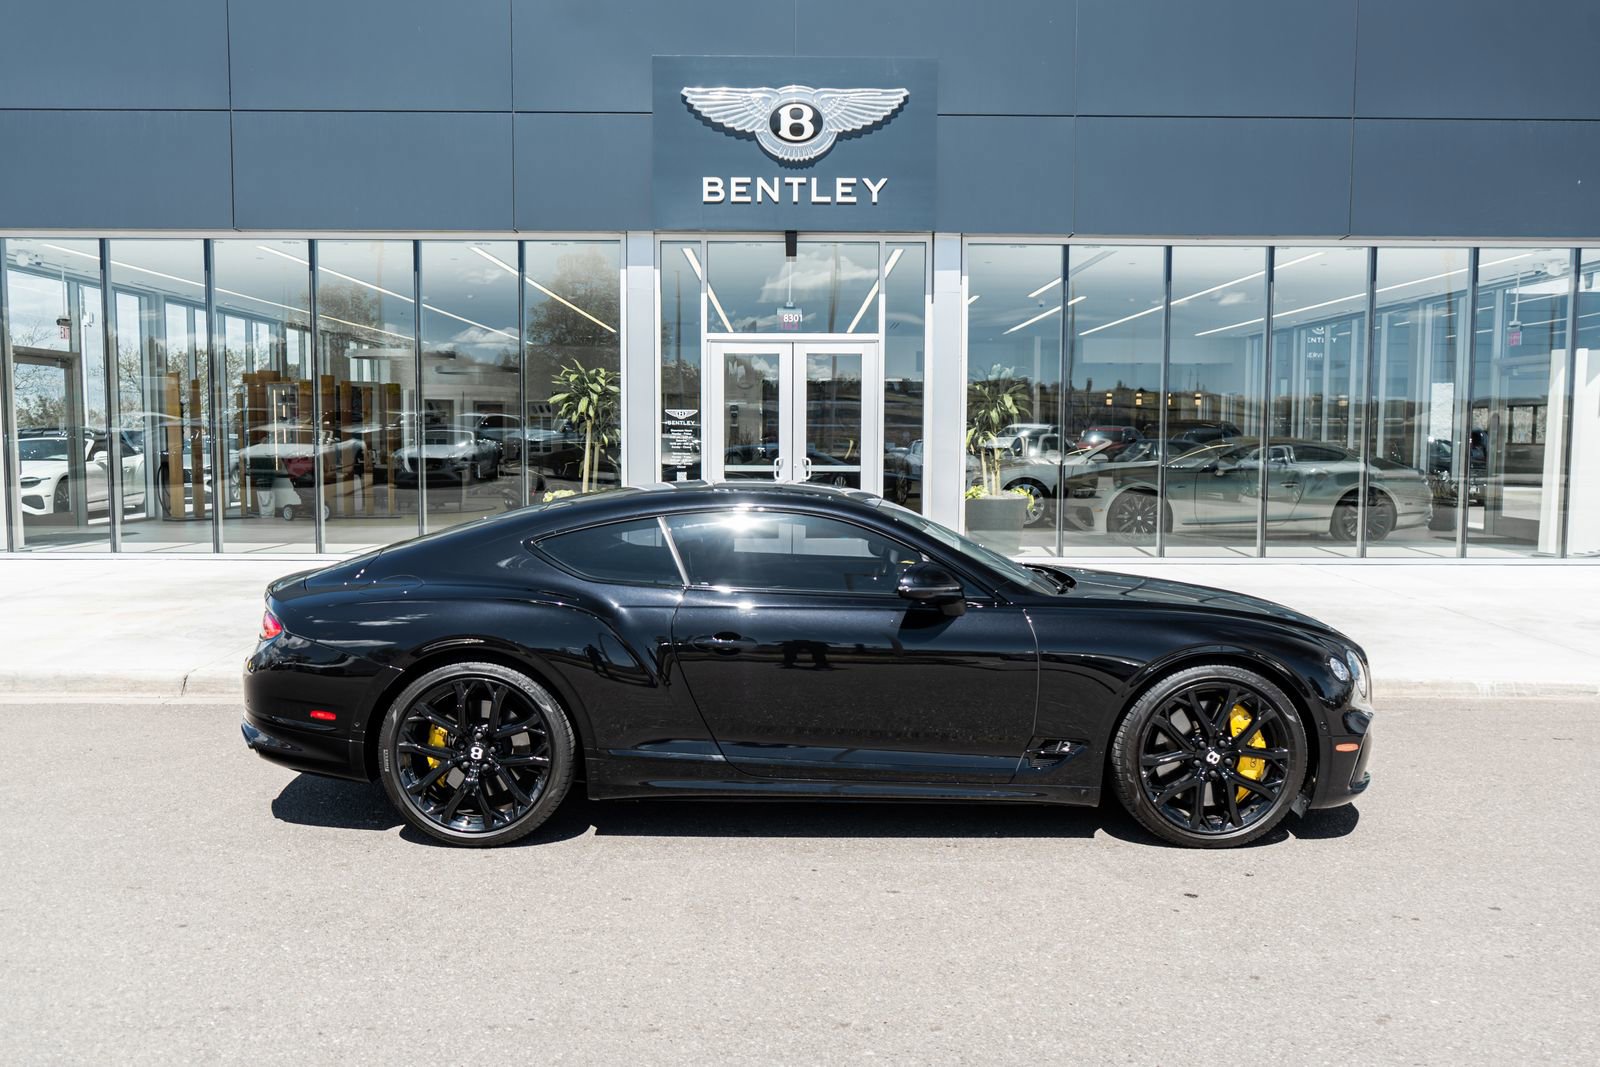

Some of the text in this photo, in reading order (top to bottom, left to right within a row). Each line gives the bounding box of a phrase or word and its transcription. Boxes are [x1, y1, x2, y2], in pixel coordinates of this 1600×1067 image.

[778, 103, 815, 141] B
[702, 177, 888, 203] BENTLEY
[783, 314, 803, 322] 8301
[470, 747, 484, 760] B
[1056, 741, 1071, 753] 12
[1206, 750, 1221, 764] B
